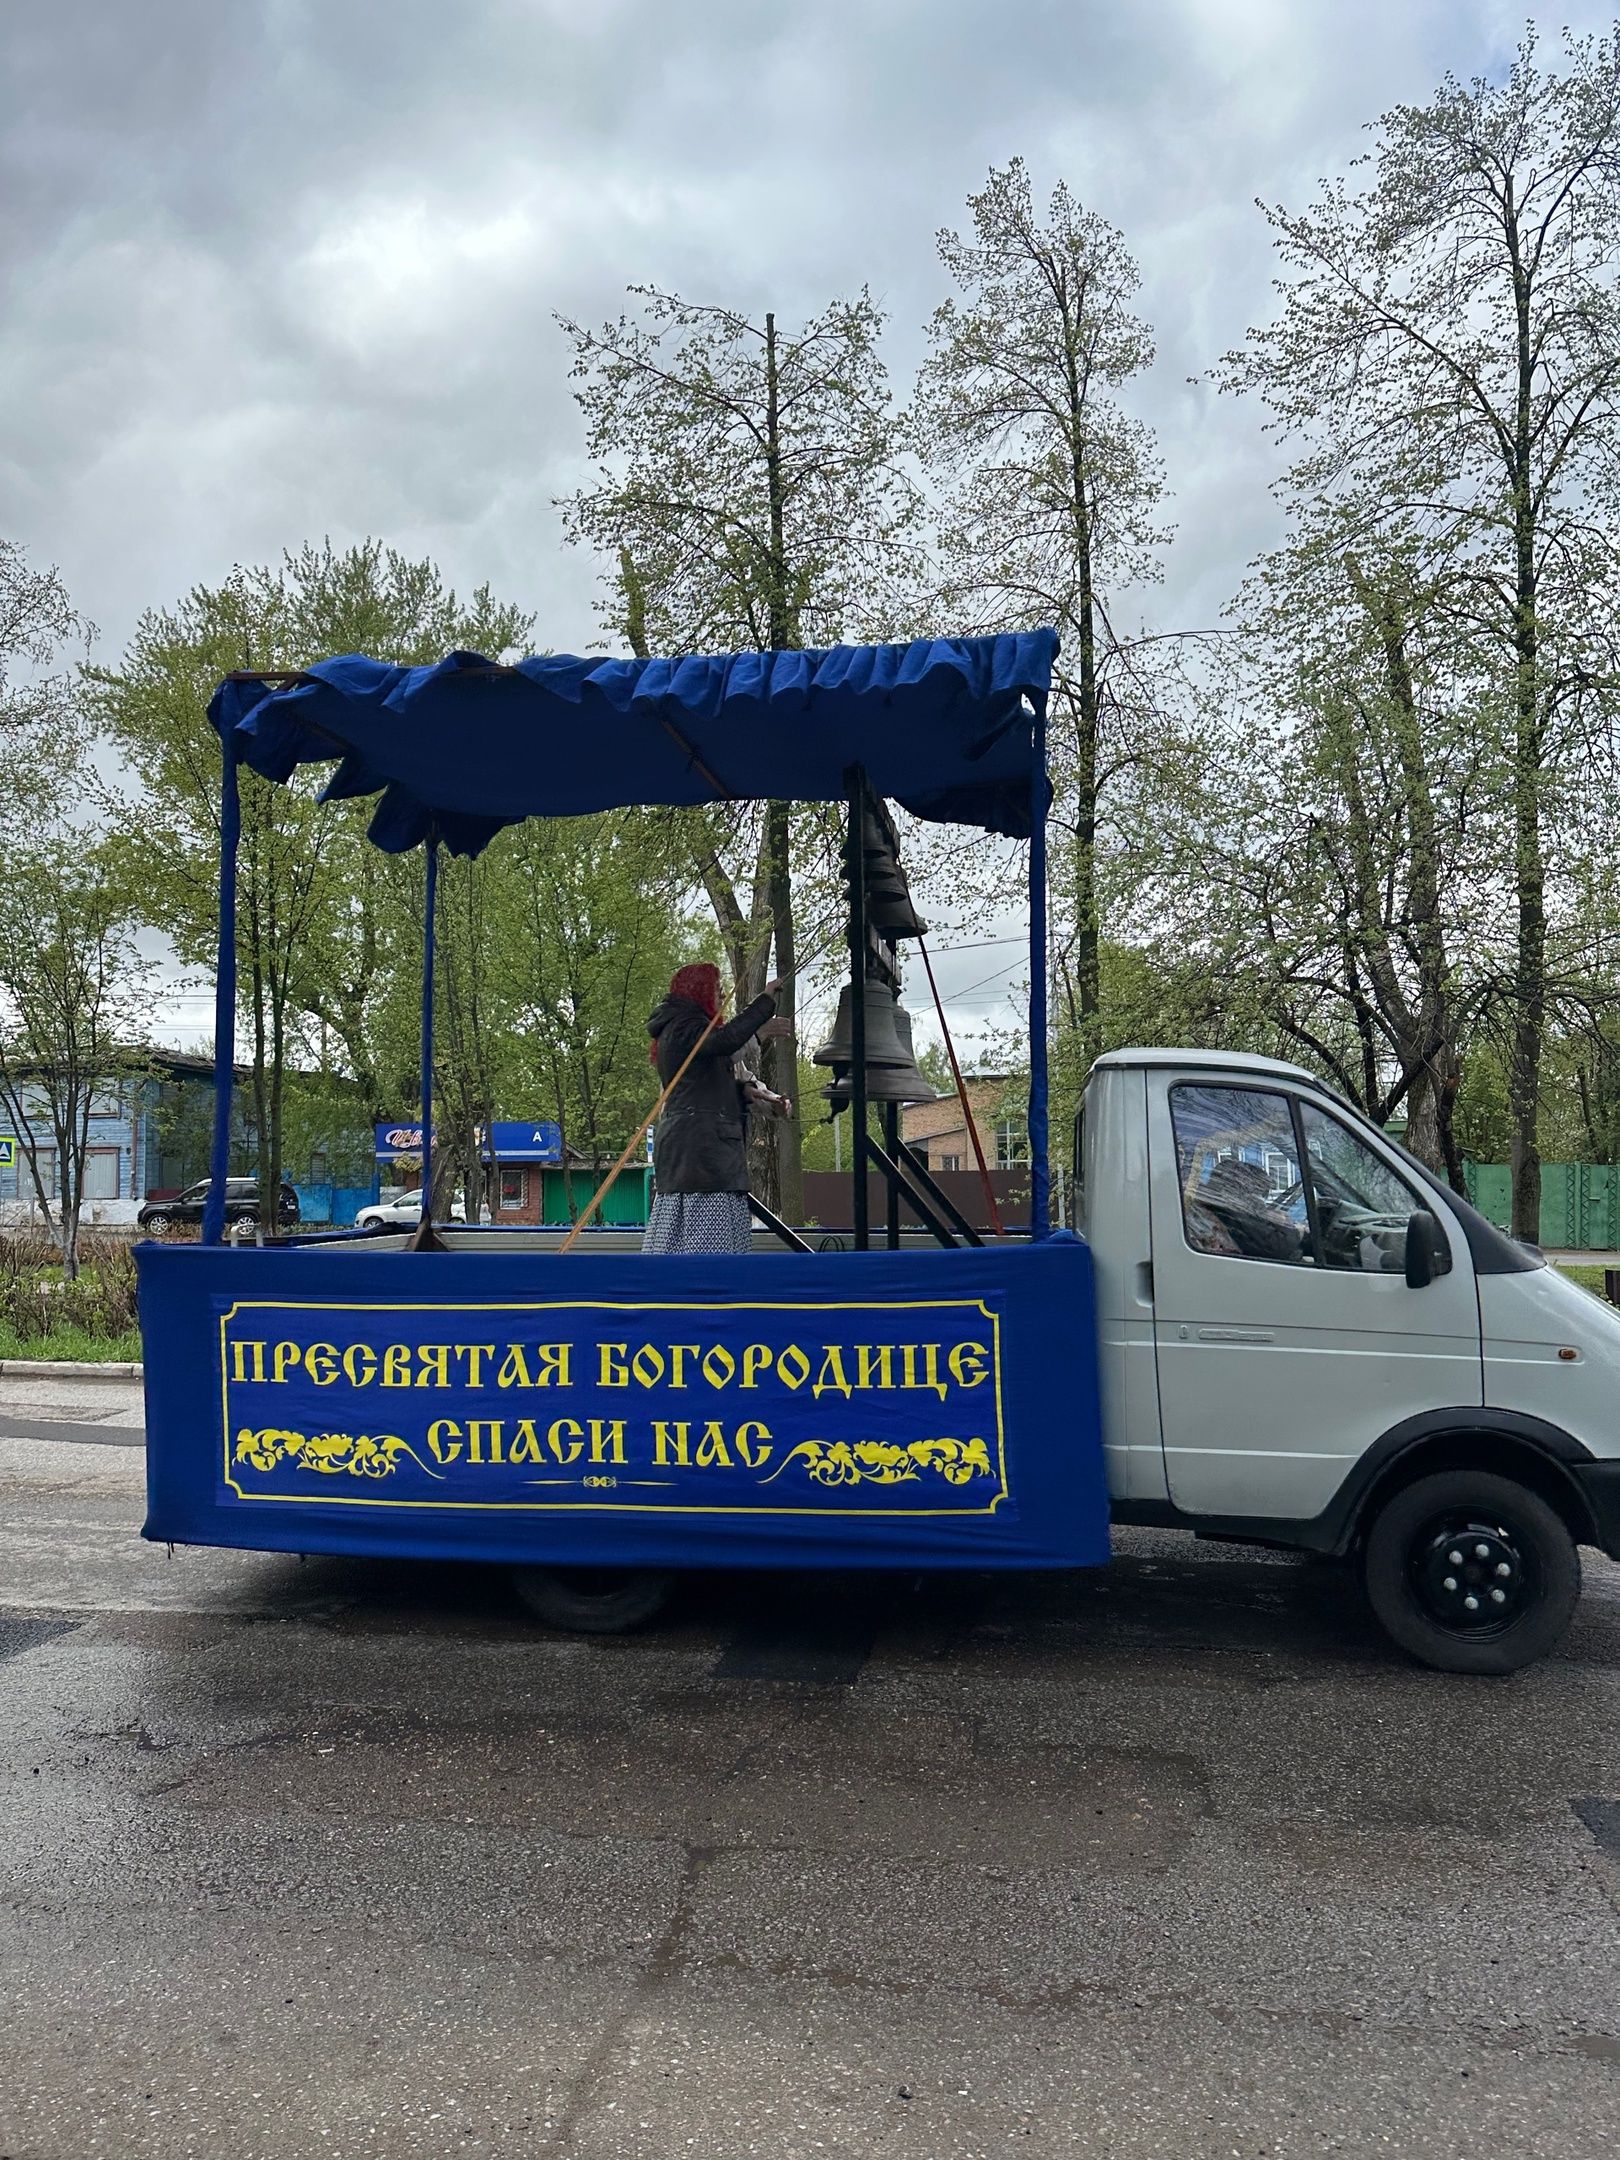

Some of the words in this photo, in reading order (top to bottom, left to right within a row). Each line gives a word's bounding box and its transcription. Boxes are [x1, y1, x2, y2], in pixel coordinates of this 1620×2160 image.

[230, 1341, 573, 1388] ПРЕСВЯТАЯ
[596, 1341, 989, 1402] БОГОРОДИЦЕ
[427, 1418, 628, 1464] СПАСИ
[651, 1421, 774, 1468] НАС
